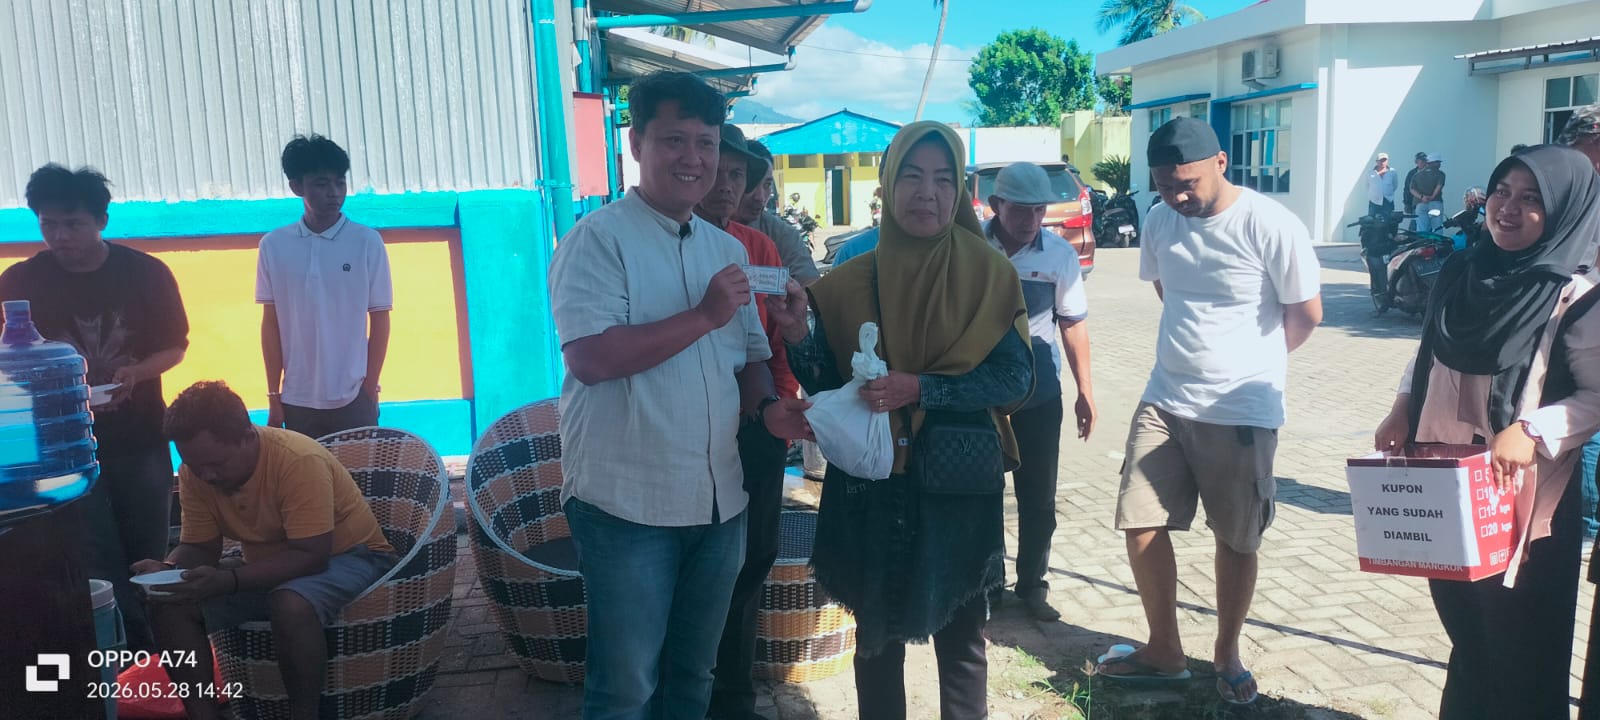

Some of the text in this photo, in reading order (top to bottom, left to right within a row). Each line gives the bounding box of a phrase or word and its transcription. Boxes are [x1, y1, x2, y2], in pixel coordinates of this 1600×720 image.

[1382, 483, 1423, 494] KUPON
[1367, 506, 1444, 519] YANG SUDAH
[1487, 522, 1498, 536] 20
[1383, 530, 1433, 542] DIAMBIL
